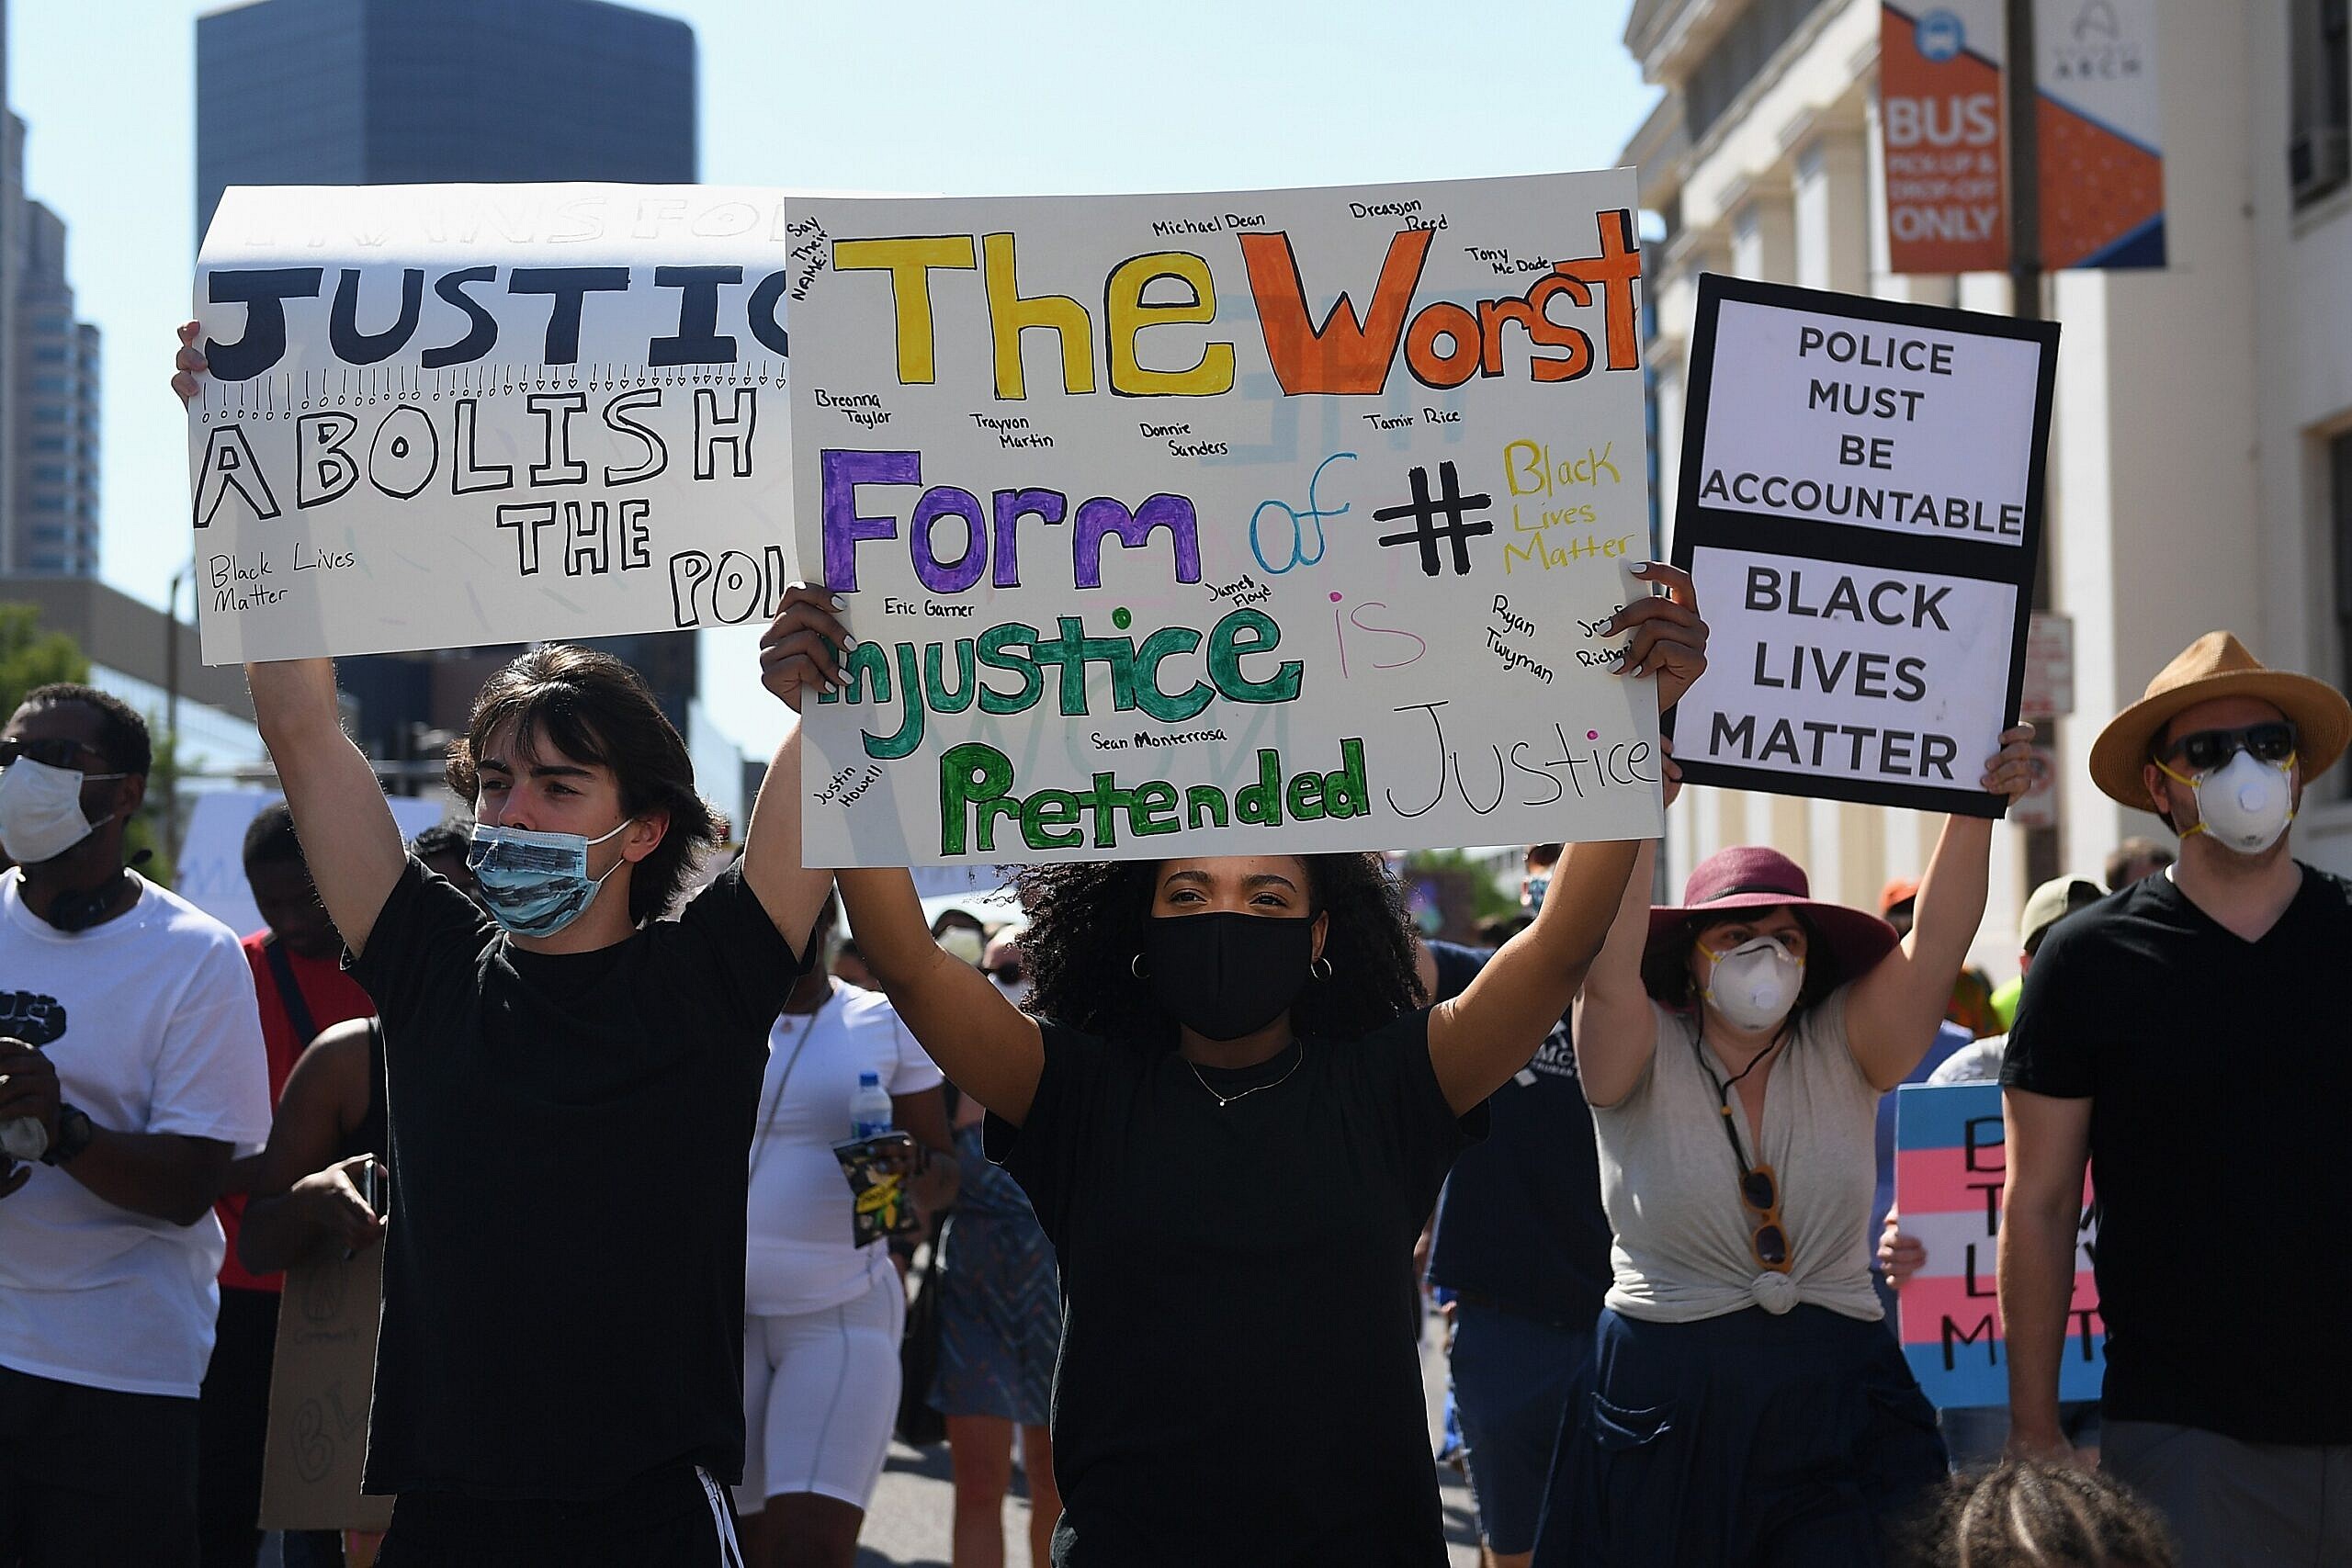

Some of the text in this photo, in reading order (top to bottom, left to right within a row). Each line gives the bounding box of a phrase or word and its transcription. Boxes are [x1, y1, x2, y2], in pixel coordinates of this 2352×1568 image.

[1886, 95, 1996, 147] BUS
[786, 216, 821, 238] Say
[1152, 213, 1266, 237] Michael Dean
[1891, 204, 1998, 243] ONLY
[790, 230, 829, 261] Their
[1464, 247, 1509, 264] Tony
[1492, 255, 1551, 276] Mc Dade
[831, 208, 1641, 399] The Worst
[1799, 326, 1955, 377] POLICE
[814, 389, 882, 409] Breonna
[1363, 407, 1461, 431] Tamir Rice
[1808, 378, 1925, 422] MUST
[841, 410, 892, 430] Taylor
[968, 412, 1030, 431] Trayvon
[1139, 423, 1192, 438] Donnie
[193, 388, 757, 528] ABOLISH
[1000, 433, 1054, 449] Martin
[1169, 440, 1228, 457] Sanders
[1839, 434, 1894, 469] BE
[1504, 439, 1622, 497] Black
[820, 449, 1202, 593] Form
[1249, 452, 1358, 575] of
[1372, 460, 1494, 577] #
[1513, 502, 1597, 533] Lives
[1701, 468, 2024, 536] ACCOUNTABLE
[496, 499, 650, 577] THE
[1503, 530, 1637, 575] Matter
[209, 543, 355, 589] Black Lives
[214, 583, 288, 613] Matter
[885, 598, 917, 615] Eric
[1231, 583, 1272, 607] Floyd
[1745, 565, 1952, 631] BLACK
[1492, 594, 1535, 637] Ryan
[1328, 592, 1427, 680] is
[1486, 626, 1554, 684] Twyman
[1753, 641, 1928, 703] LIVES
[1091, 728, 1228, 750] Sean Monterrosa
[1709, 712, 1958, 781] MATTER
[813, 765, 856, 805] Justin
[839, 764, 883, 808] Howell
[940, 700, 1660, 856] Pretended Justice
